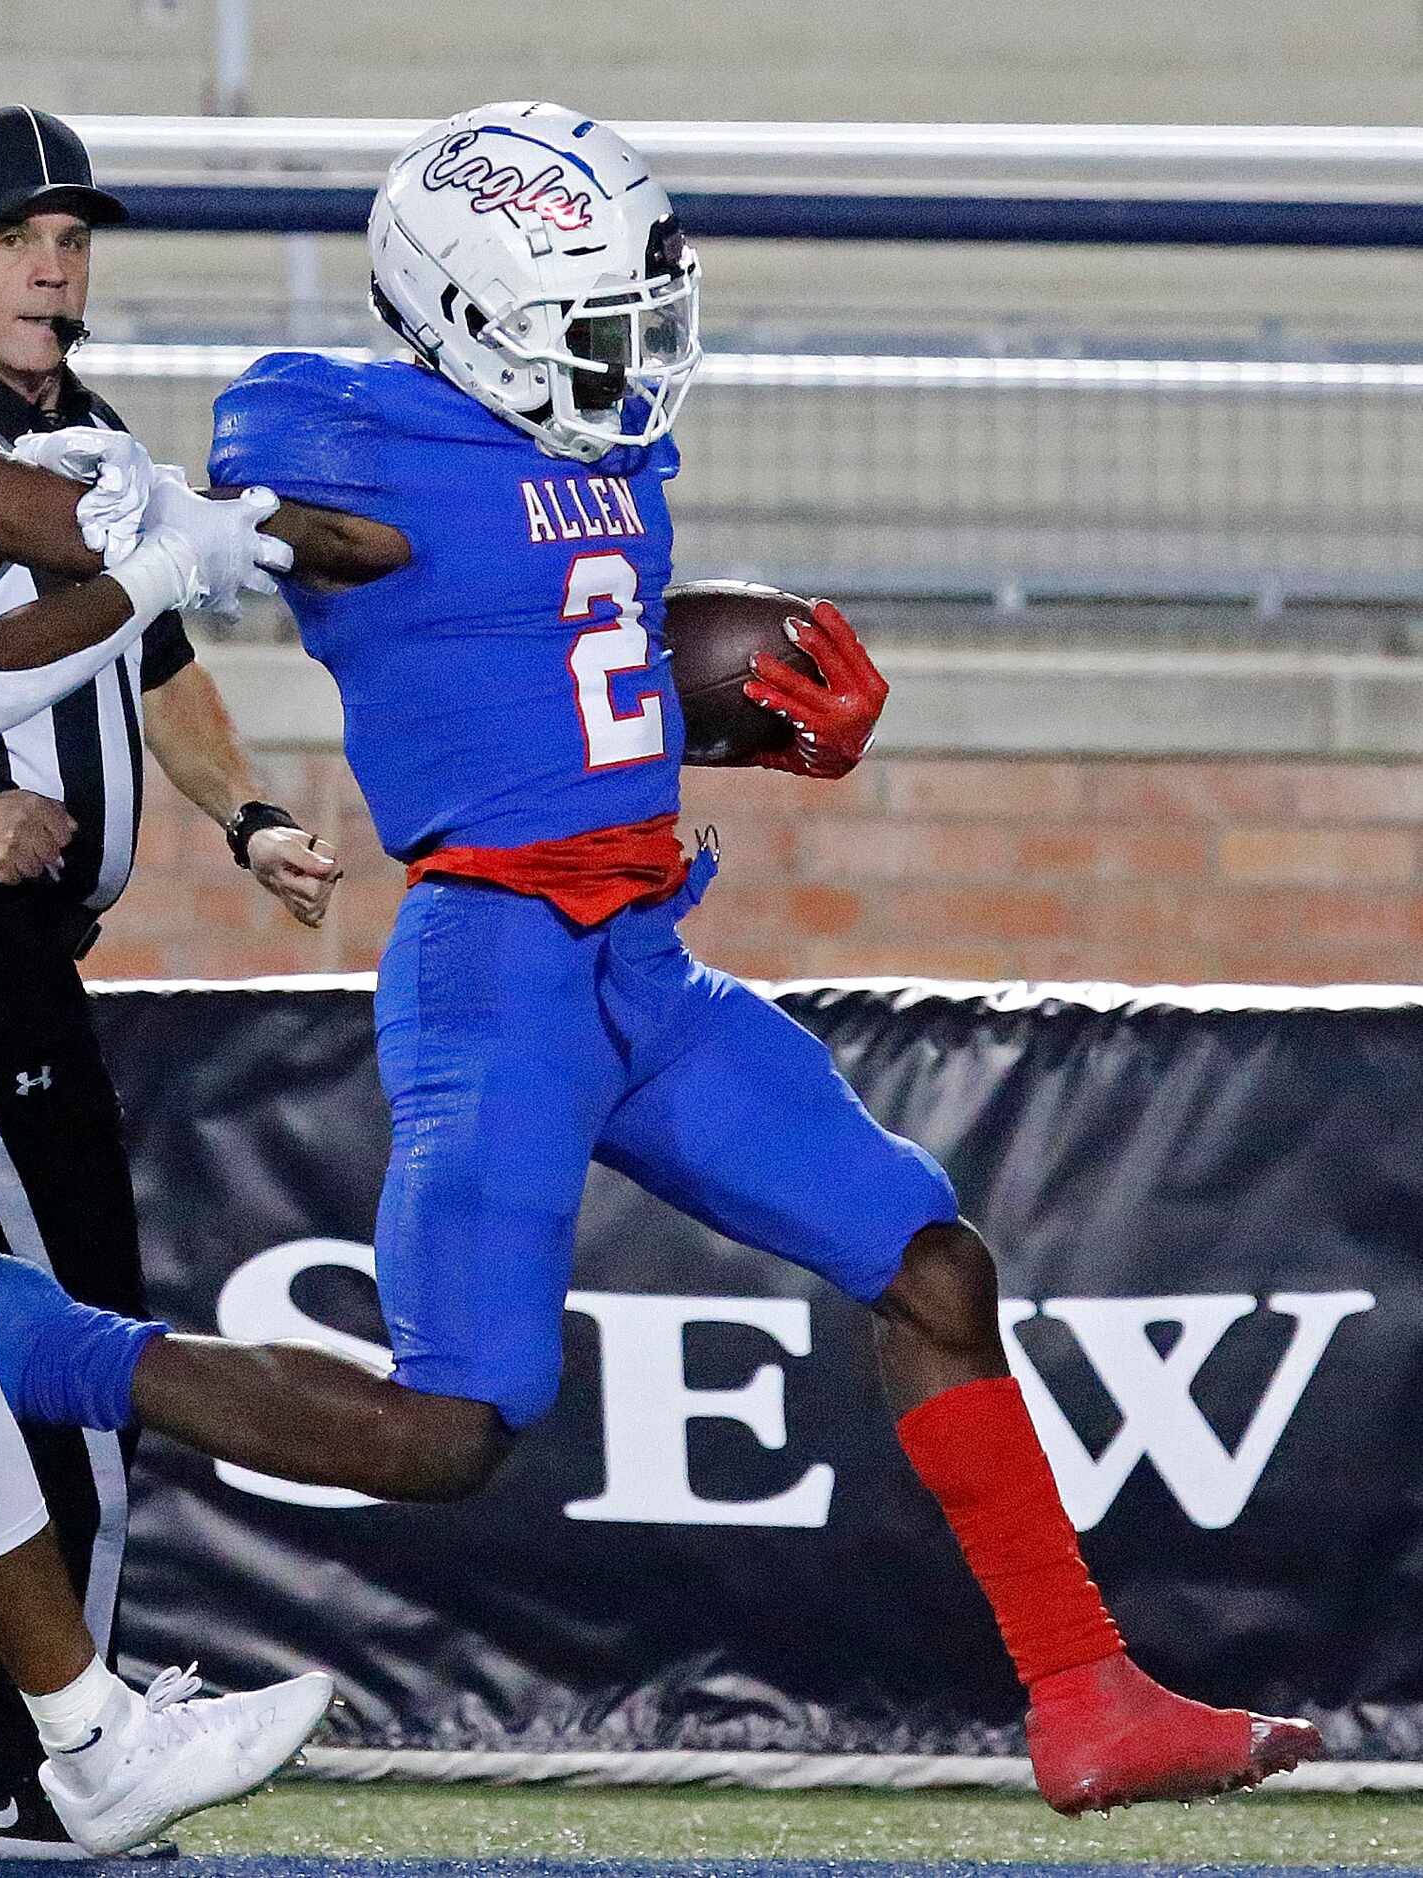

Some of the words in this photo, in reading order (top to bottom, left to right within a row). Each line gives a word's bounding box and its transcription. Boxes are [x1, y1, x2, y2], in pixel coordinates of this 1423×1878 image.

[423, 130, 592, 231] Eagles
[521, 476, 646, 543] ALLEN
[560, 549, 668, 772] 2
